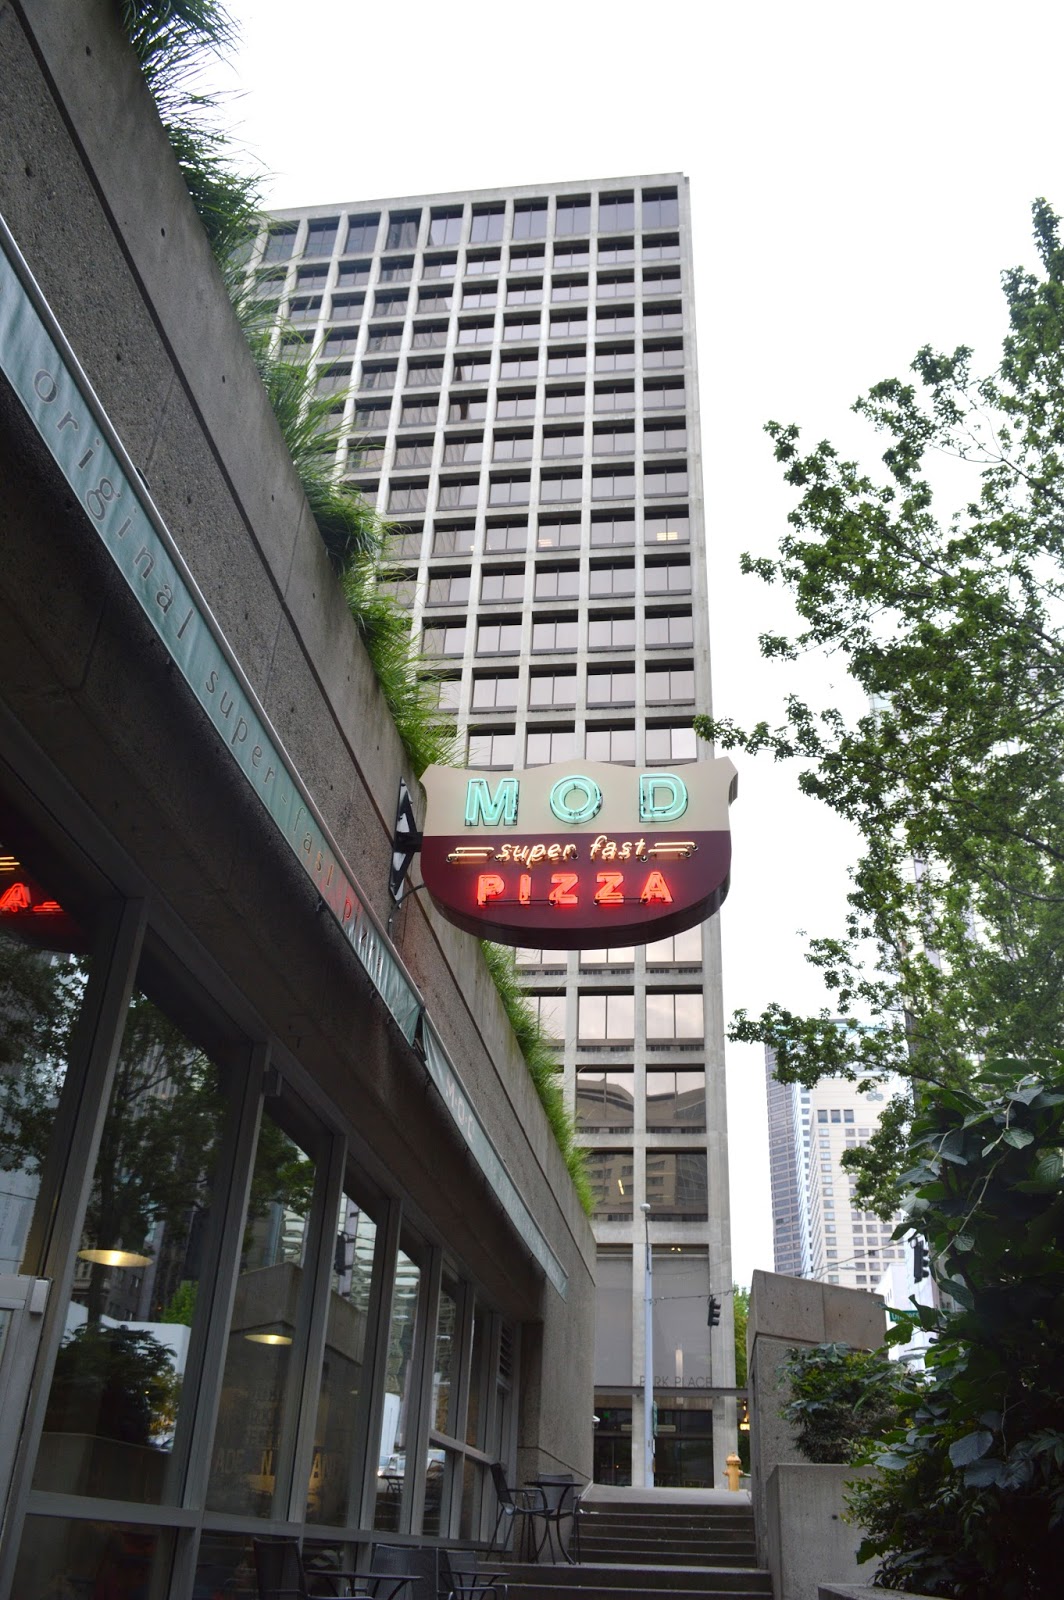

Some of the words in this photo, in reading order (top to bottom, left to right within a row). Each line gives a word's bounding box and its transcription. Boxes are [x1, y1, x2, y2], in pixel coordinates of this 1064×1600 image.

[32, 368, 194, 640] original
[464, 772, 689, 826] MOD
[498, 842, 577, 868] super
[590, 834, 648, 860] fast
[476, 871, 674, 906] PIZZA
[639, 1375, 670, 1388] PRK
[674, 1376, 713, 1389] PLACE
